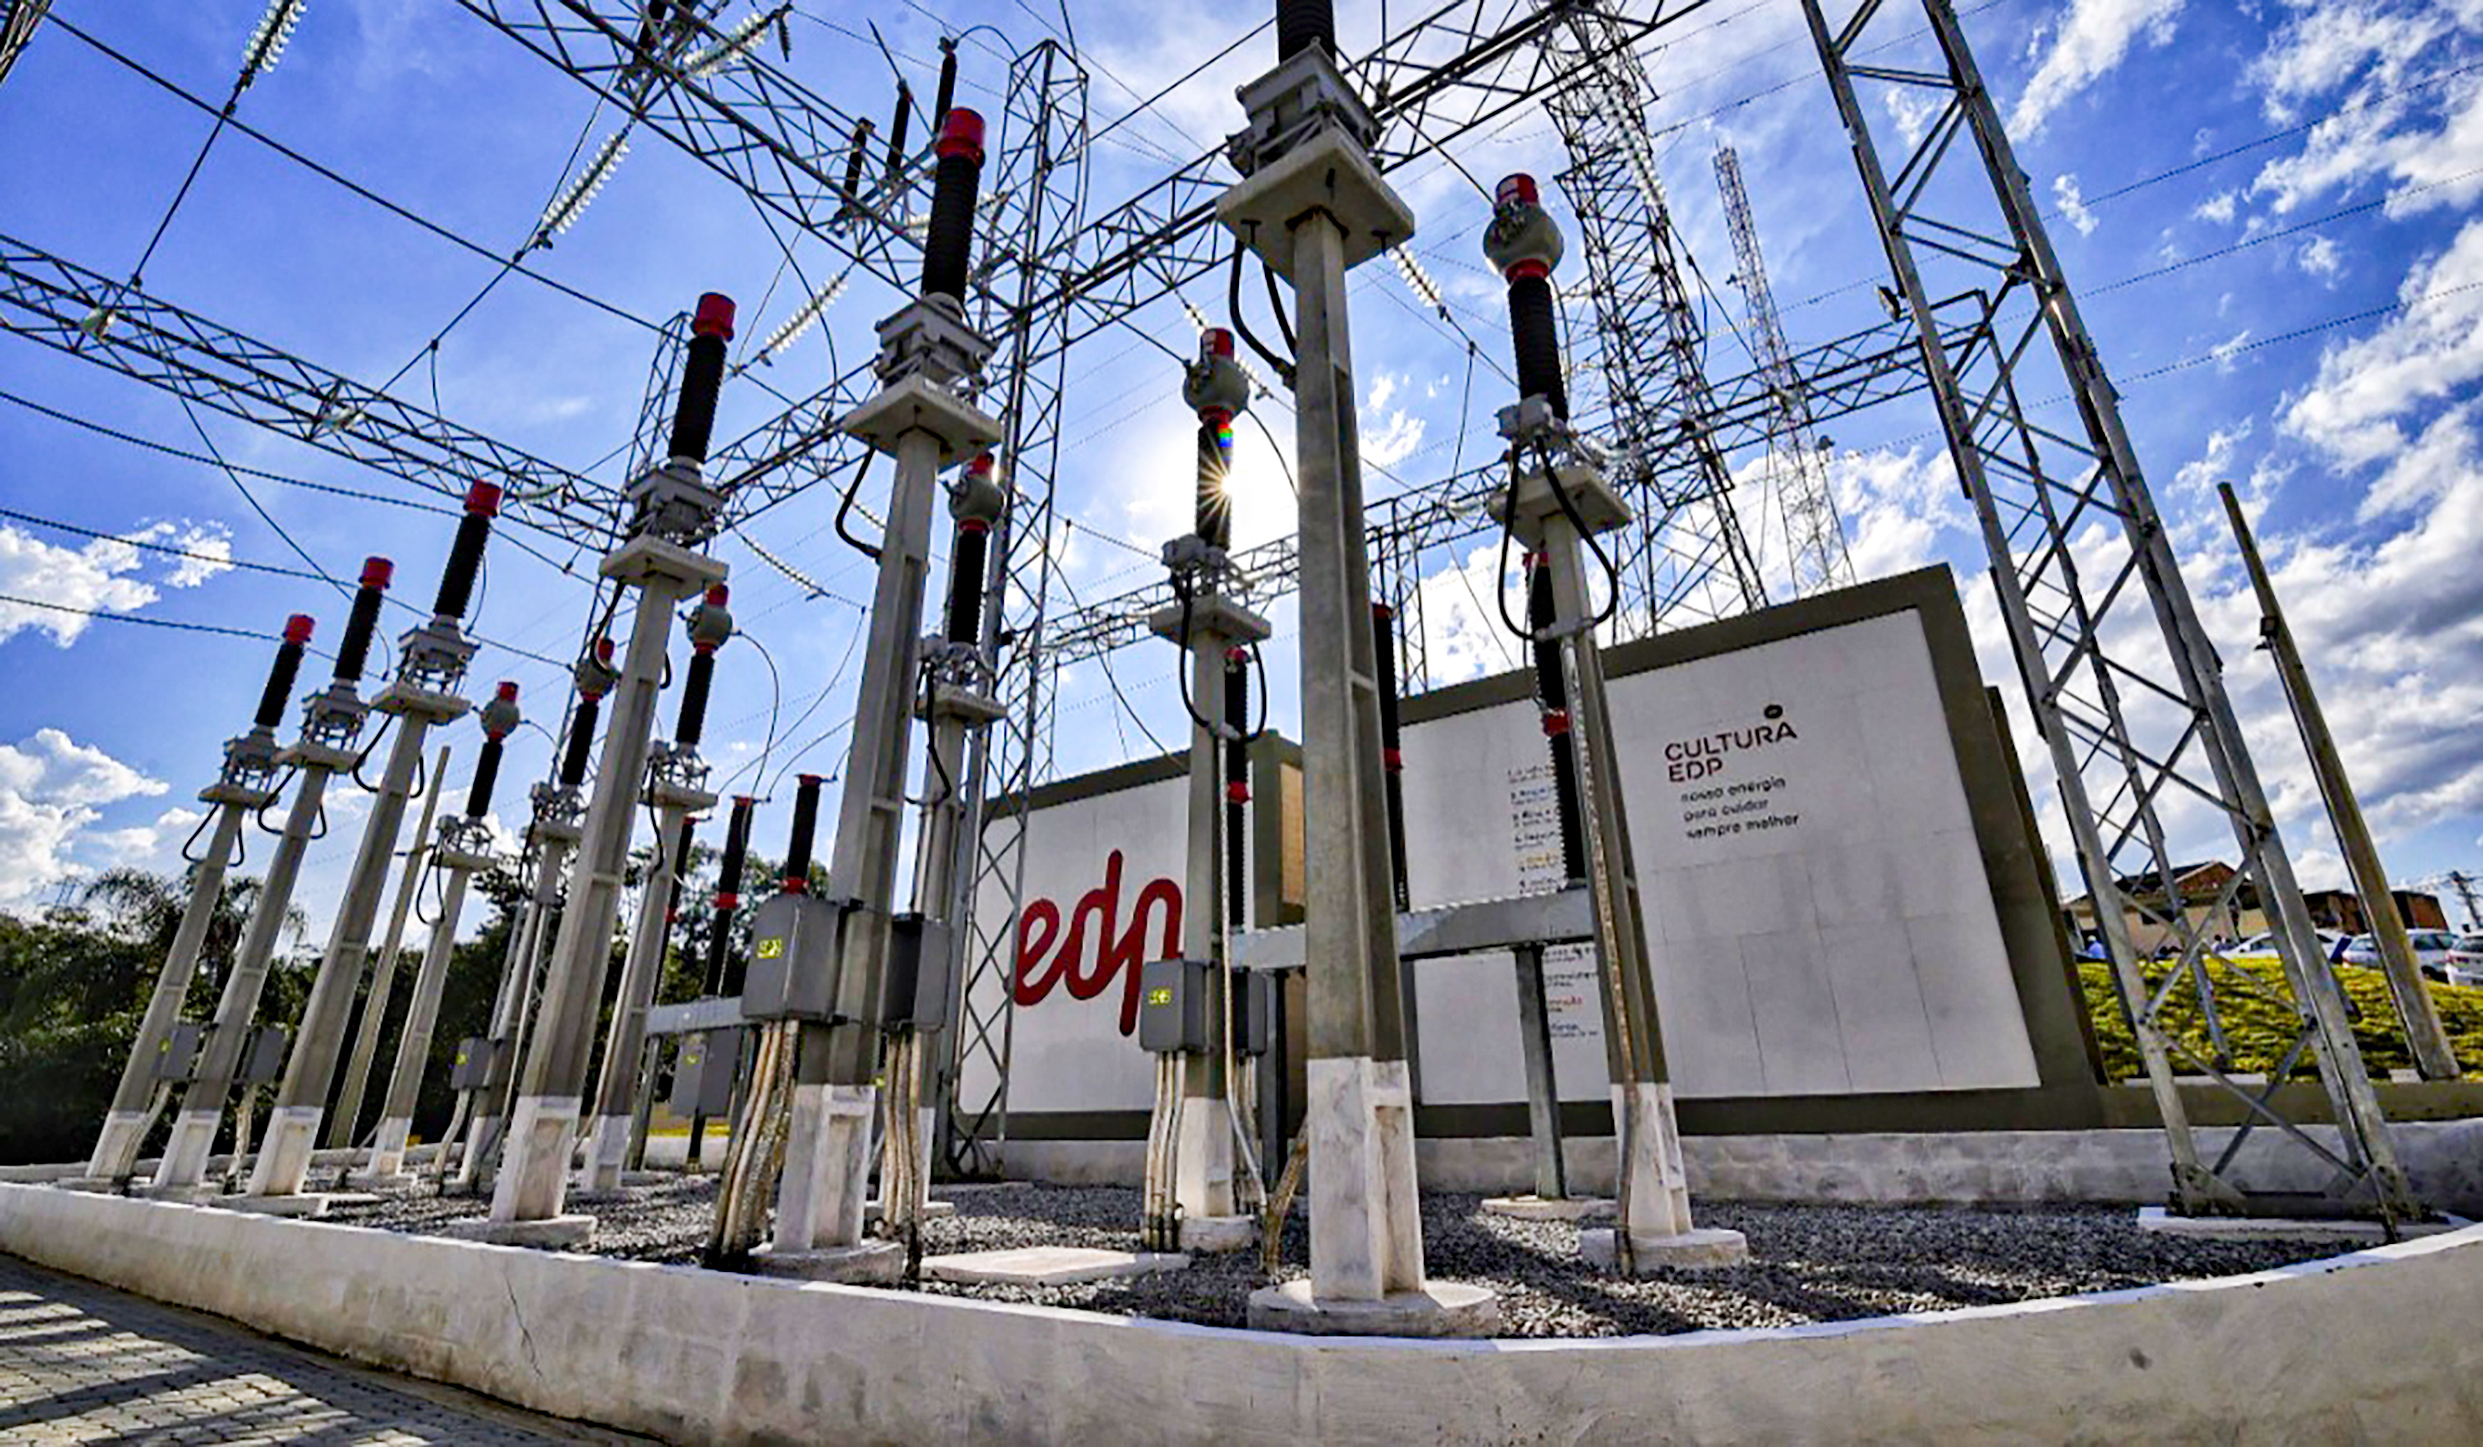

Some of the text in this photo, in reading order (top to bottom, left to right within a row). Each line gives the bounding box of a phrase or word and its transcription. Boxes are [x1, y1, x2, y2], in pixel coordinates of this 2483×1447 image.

[1664, 721, 1797, 761] CULTURA
[1668, 757, 1723, 782] EDP
[1727, 776, 1786, 796] energia
[1683, 799, 1769, 822] para cuidar
[1686, 814, 1799, 838] sempre melhor
[1005, 848, 1183, 1037] edp
